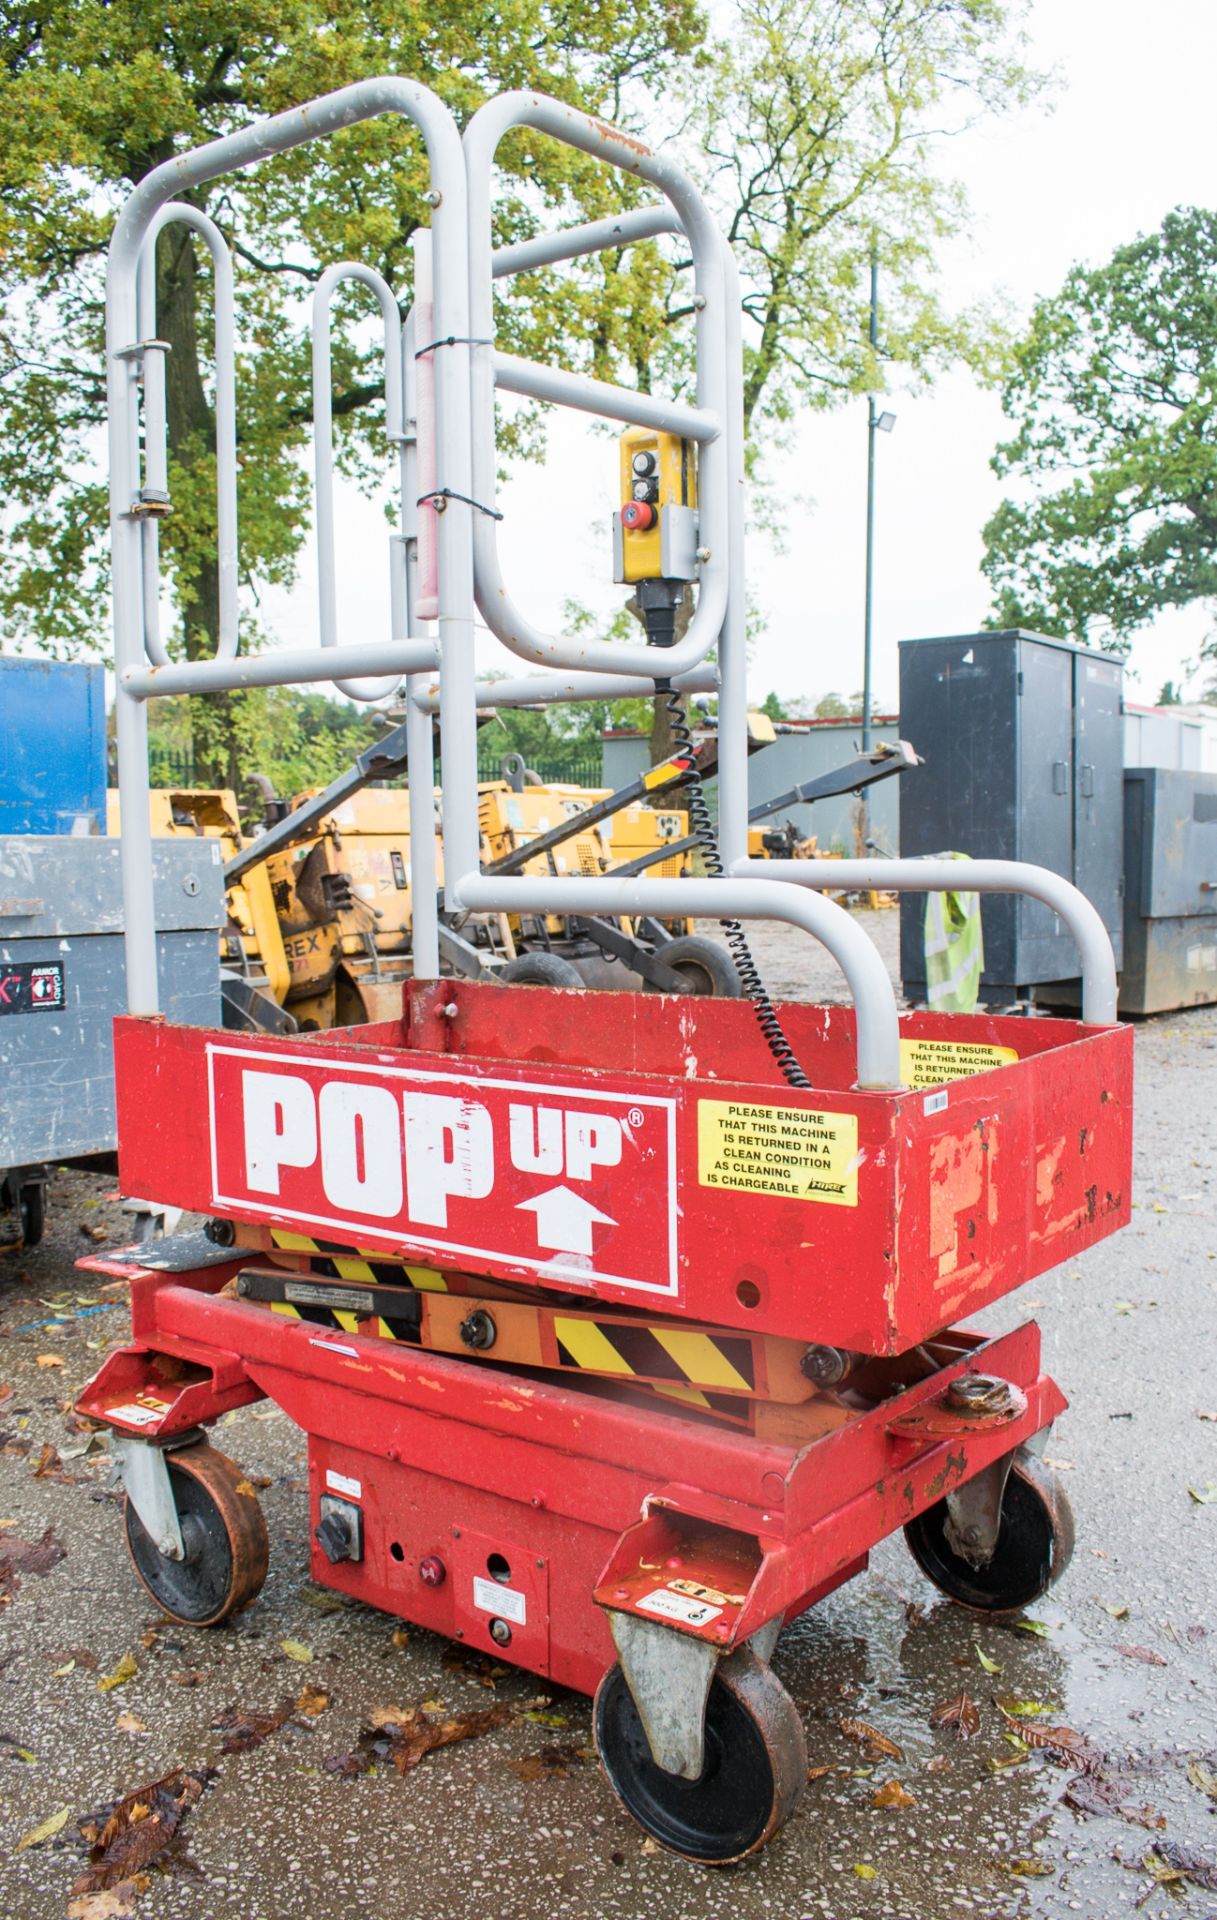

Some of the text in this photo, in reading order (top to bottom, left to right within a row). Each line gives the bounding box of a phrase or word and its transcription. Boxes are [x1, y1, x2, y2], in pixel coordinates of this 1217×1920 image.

[918, 1043, 994, 1056] PLEASE ENSURE
[910, 1053, 1003, 1067] THAT THIS MACHINE
[914, 1064, 923, 1072] IS
[926, 1065, 976, 1076] RETURNED
[914, 1074, 944, 1084] CLEAN
[728, 1106, 825, 1125] PLEASE ENSURE
[718, 1119, 837, 1141] THAT THIS MACHINE
[242, 1069, 495, 1228] POP
[724, 1134, 831, 1155] IS RETURNED IN A
[723, 1148, 832, 1169] CLEAN CONDITION
[714, 1161, 792, 1179] AS CLEANING
[707, 1173, 718, 1184] IS
[721, 1175, 800, 1195] CHARGEABLE
